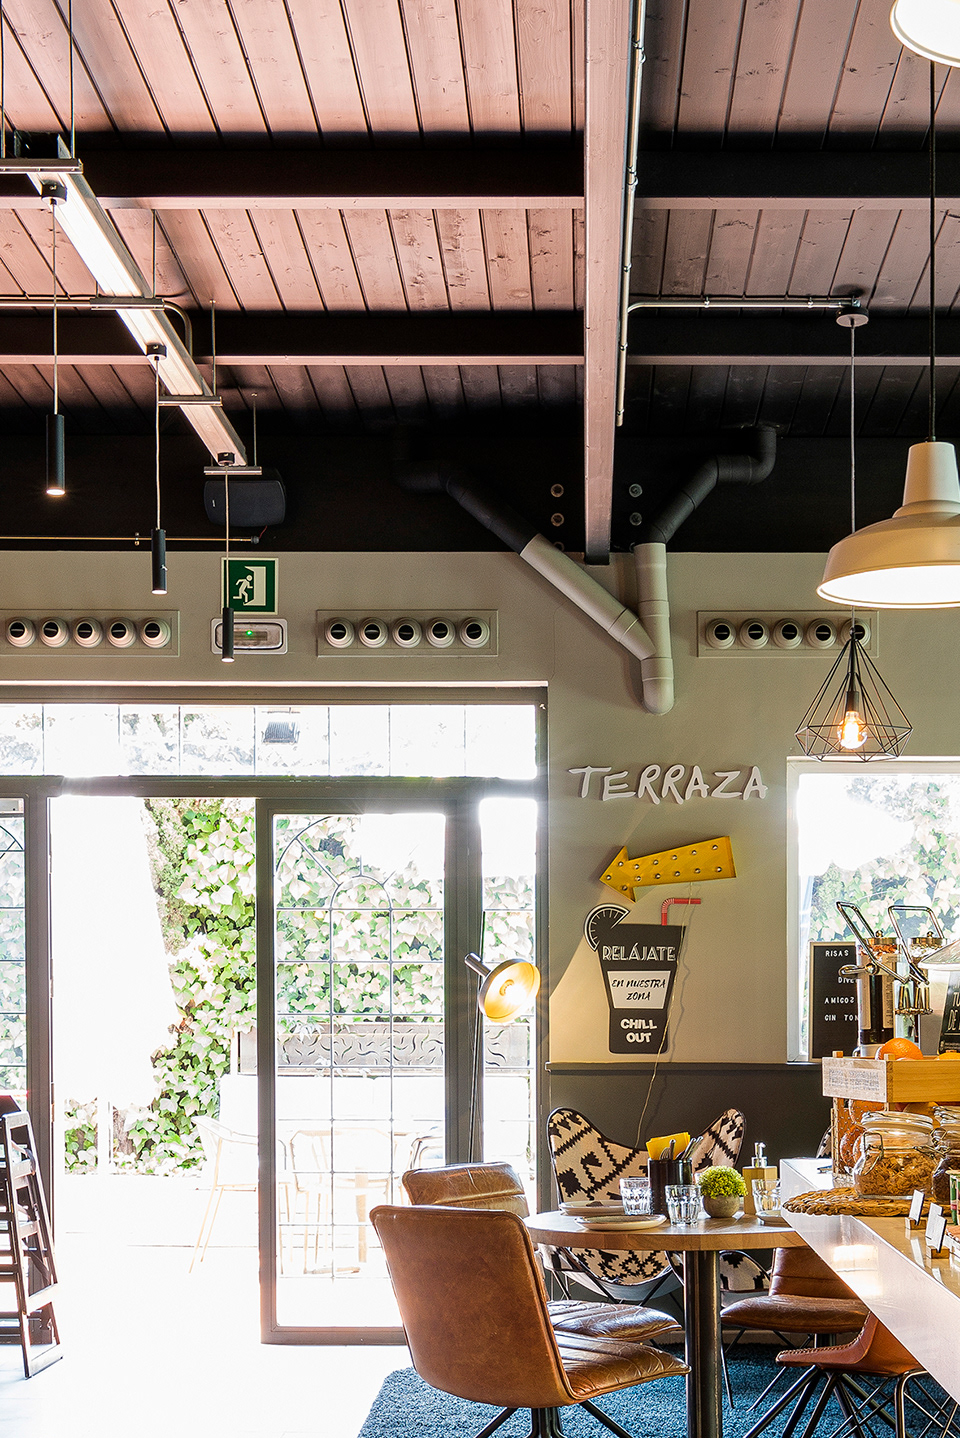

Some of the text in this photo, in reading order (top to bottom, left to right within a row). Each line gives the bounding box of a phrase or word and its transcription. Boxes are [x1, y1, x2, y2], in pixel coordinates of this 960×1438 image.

[568, 764, 768, 805] TERRAZA
[602, 942, 677, 961] RELÁJATE
[825, 949, 849, 957] RISAS
[611, 978, 666, 988] EN NUESTRA
[837, 976, 858, 984] DIVE
[626, 991, 651, 1001] ZONA
[620, 1018, 658, 1030] CHILL
[947, 1009, 959, 1031] DE
[626, 1032, 652, 1043] OUT
